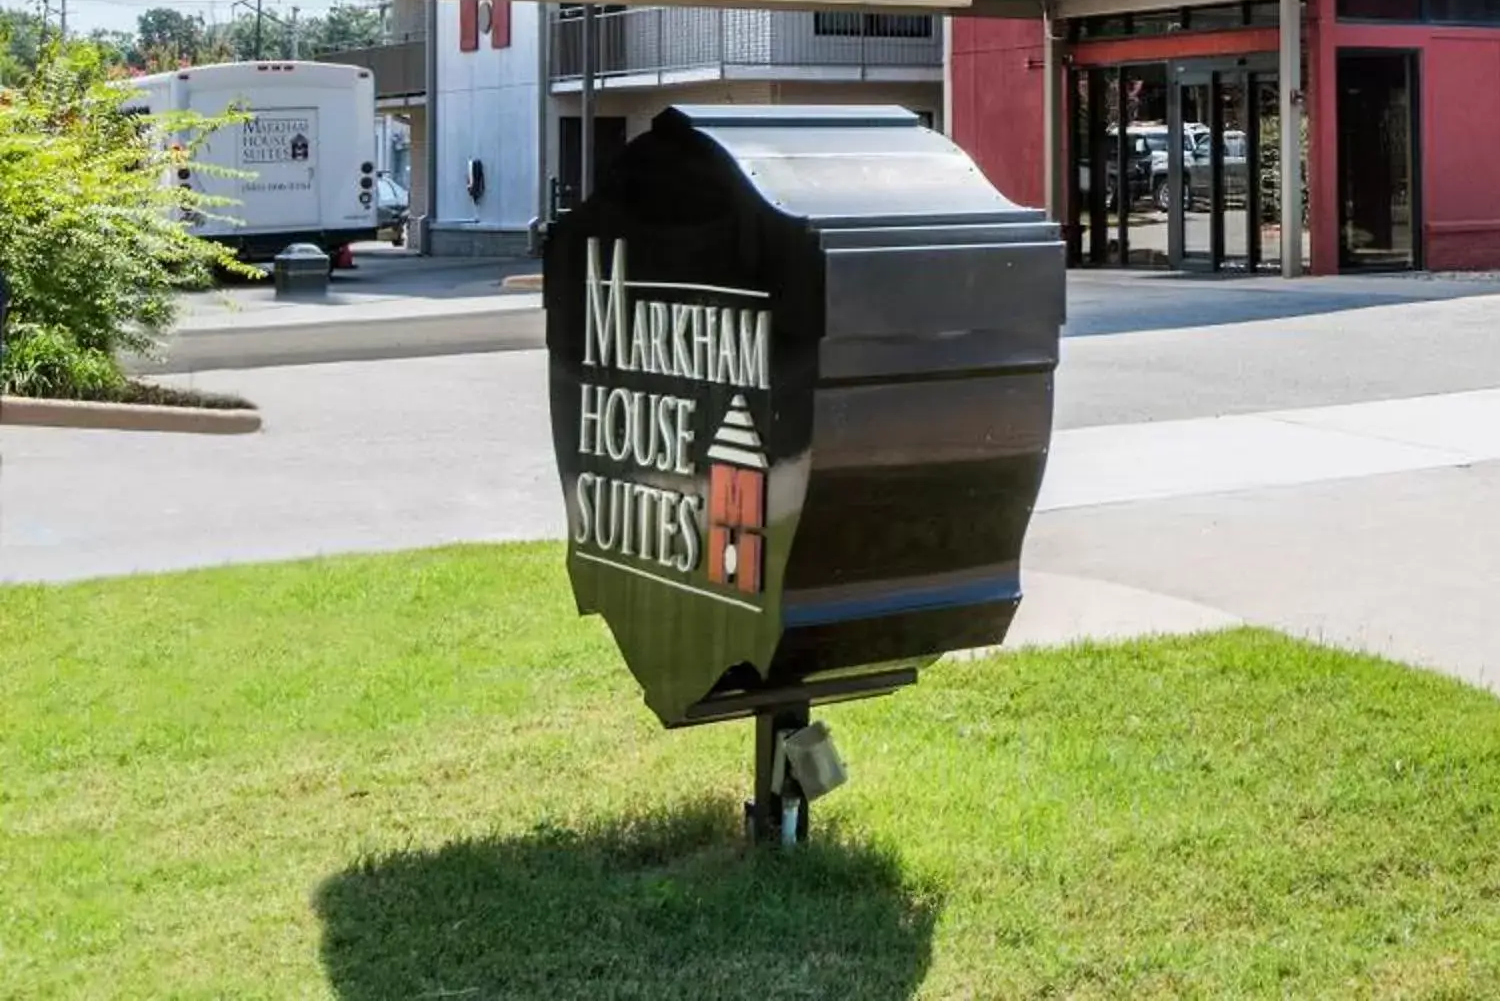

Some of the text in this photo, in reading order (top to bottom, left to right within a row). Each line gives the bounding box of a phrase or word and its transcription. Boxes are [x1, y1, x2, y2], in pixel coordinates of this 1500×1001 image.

[243, 135, 286, 147] HOUSE
[243, 148, 289, 161] SUITES
[582, 237, 770, 389] MARKHAM
[579, 385, 696, 474] HOUSE
[576, 474, 701, 573] SUITES
